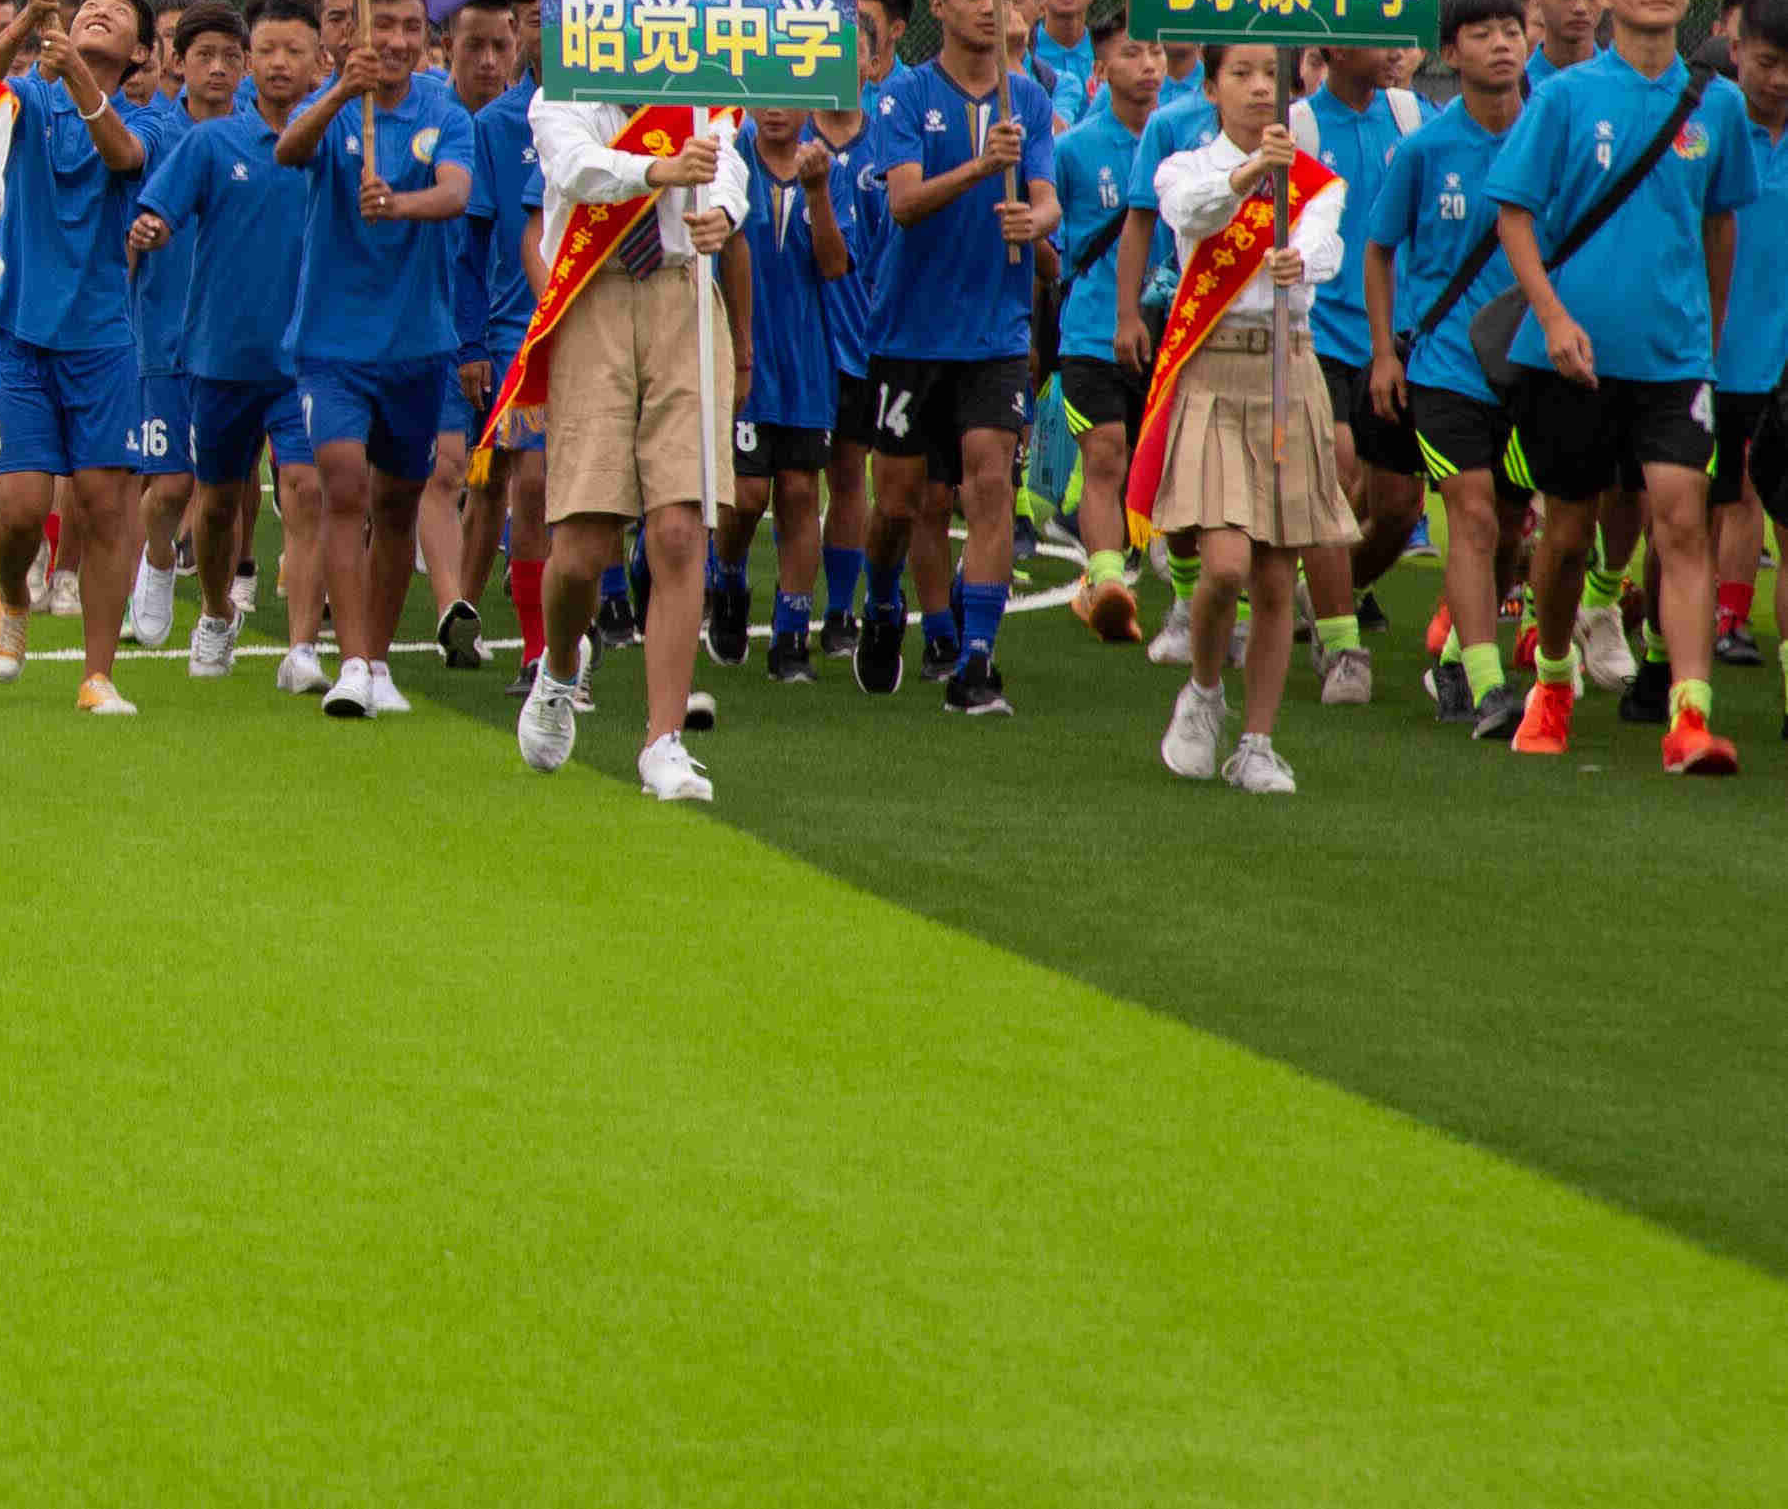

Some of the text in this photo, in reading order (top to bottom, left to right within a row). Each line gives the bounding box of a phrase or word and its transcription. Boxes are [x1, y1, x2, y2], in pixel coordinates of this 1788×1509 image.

[1596, 143, 1612, 171] 4
[1099, 184, 1119, 209] 15
[1440, 193, 1466, 220] 20
[877, 382, 912, 437] 14
[140, 418, 168, 457] 16
